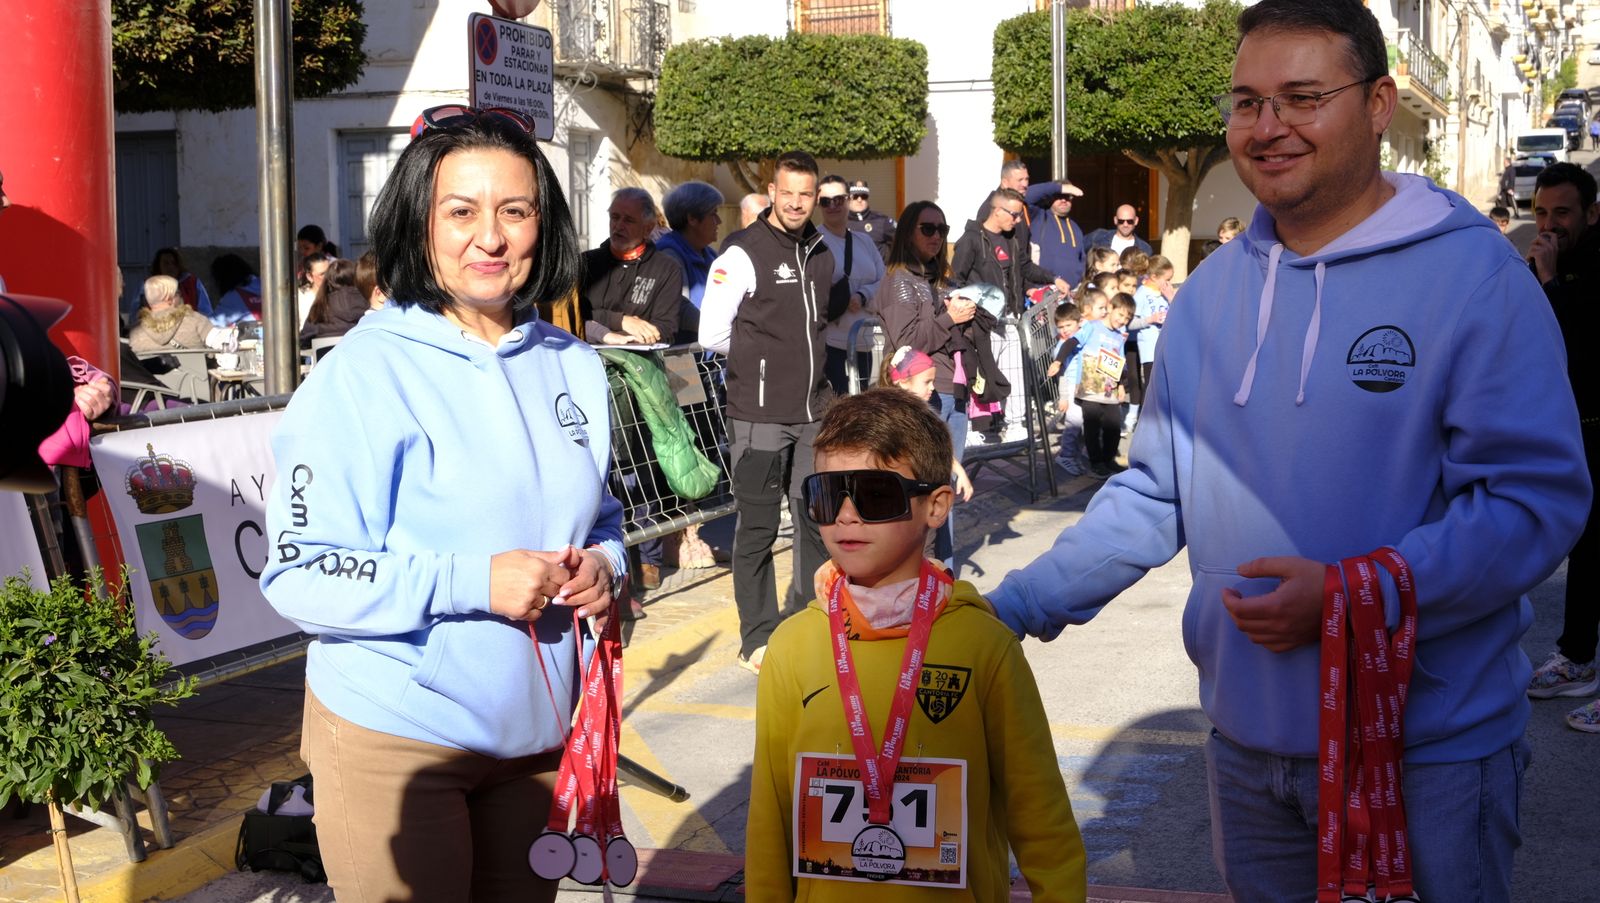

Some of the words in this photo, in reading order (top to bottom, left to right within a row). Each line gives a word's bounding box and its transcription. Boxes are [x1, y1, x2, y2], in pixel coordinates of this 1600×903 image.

[499, 25, 552, 50] PROHIBIDO
[511, 45, 535, 60] PARAR
[537, 52, 542, 61] Y
[504, 56, 549, 76] ESTACIONAR
[476, 70, 487, 83] EN
[489, 71, 513, 89] TODA
[514, 76, 526, 90] LA
[527, 79, 552, 95] PLAZA
[1352, 368, 1364, 376] LA
[935, 670, 949, 681] 20
[936, 680, 946, 690] 17
[816, 767, 828, 777] LA
